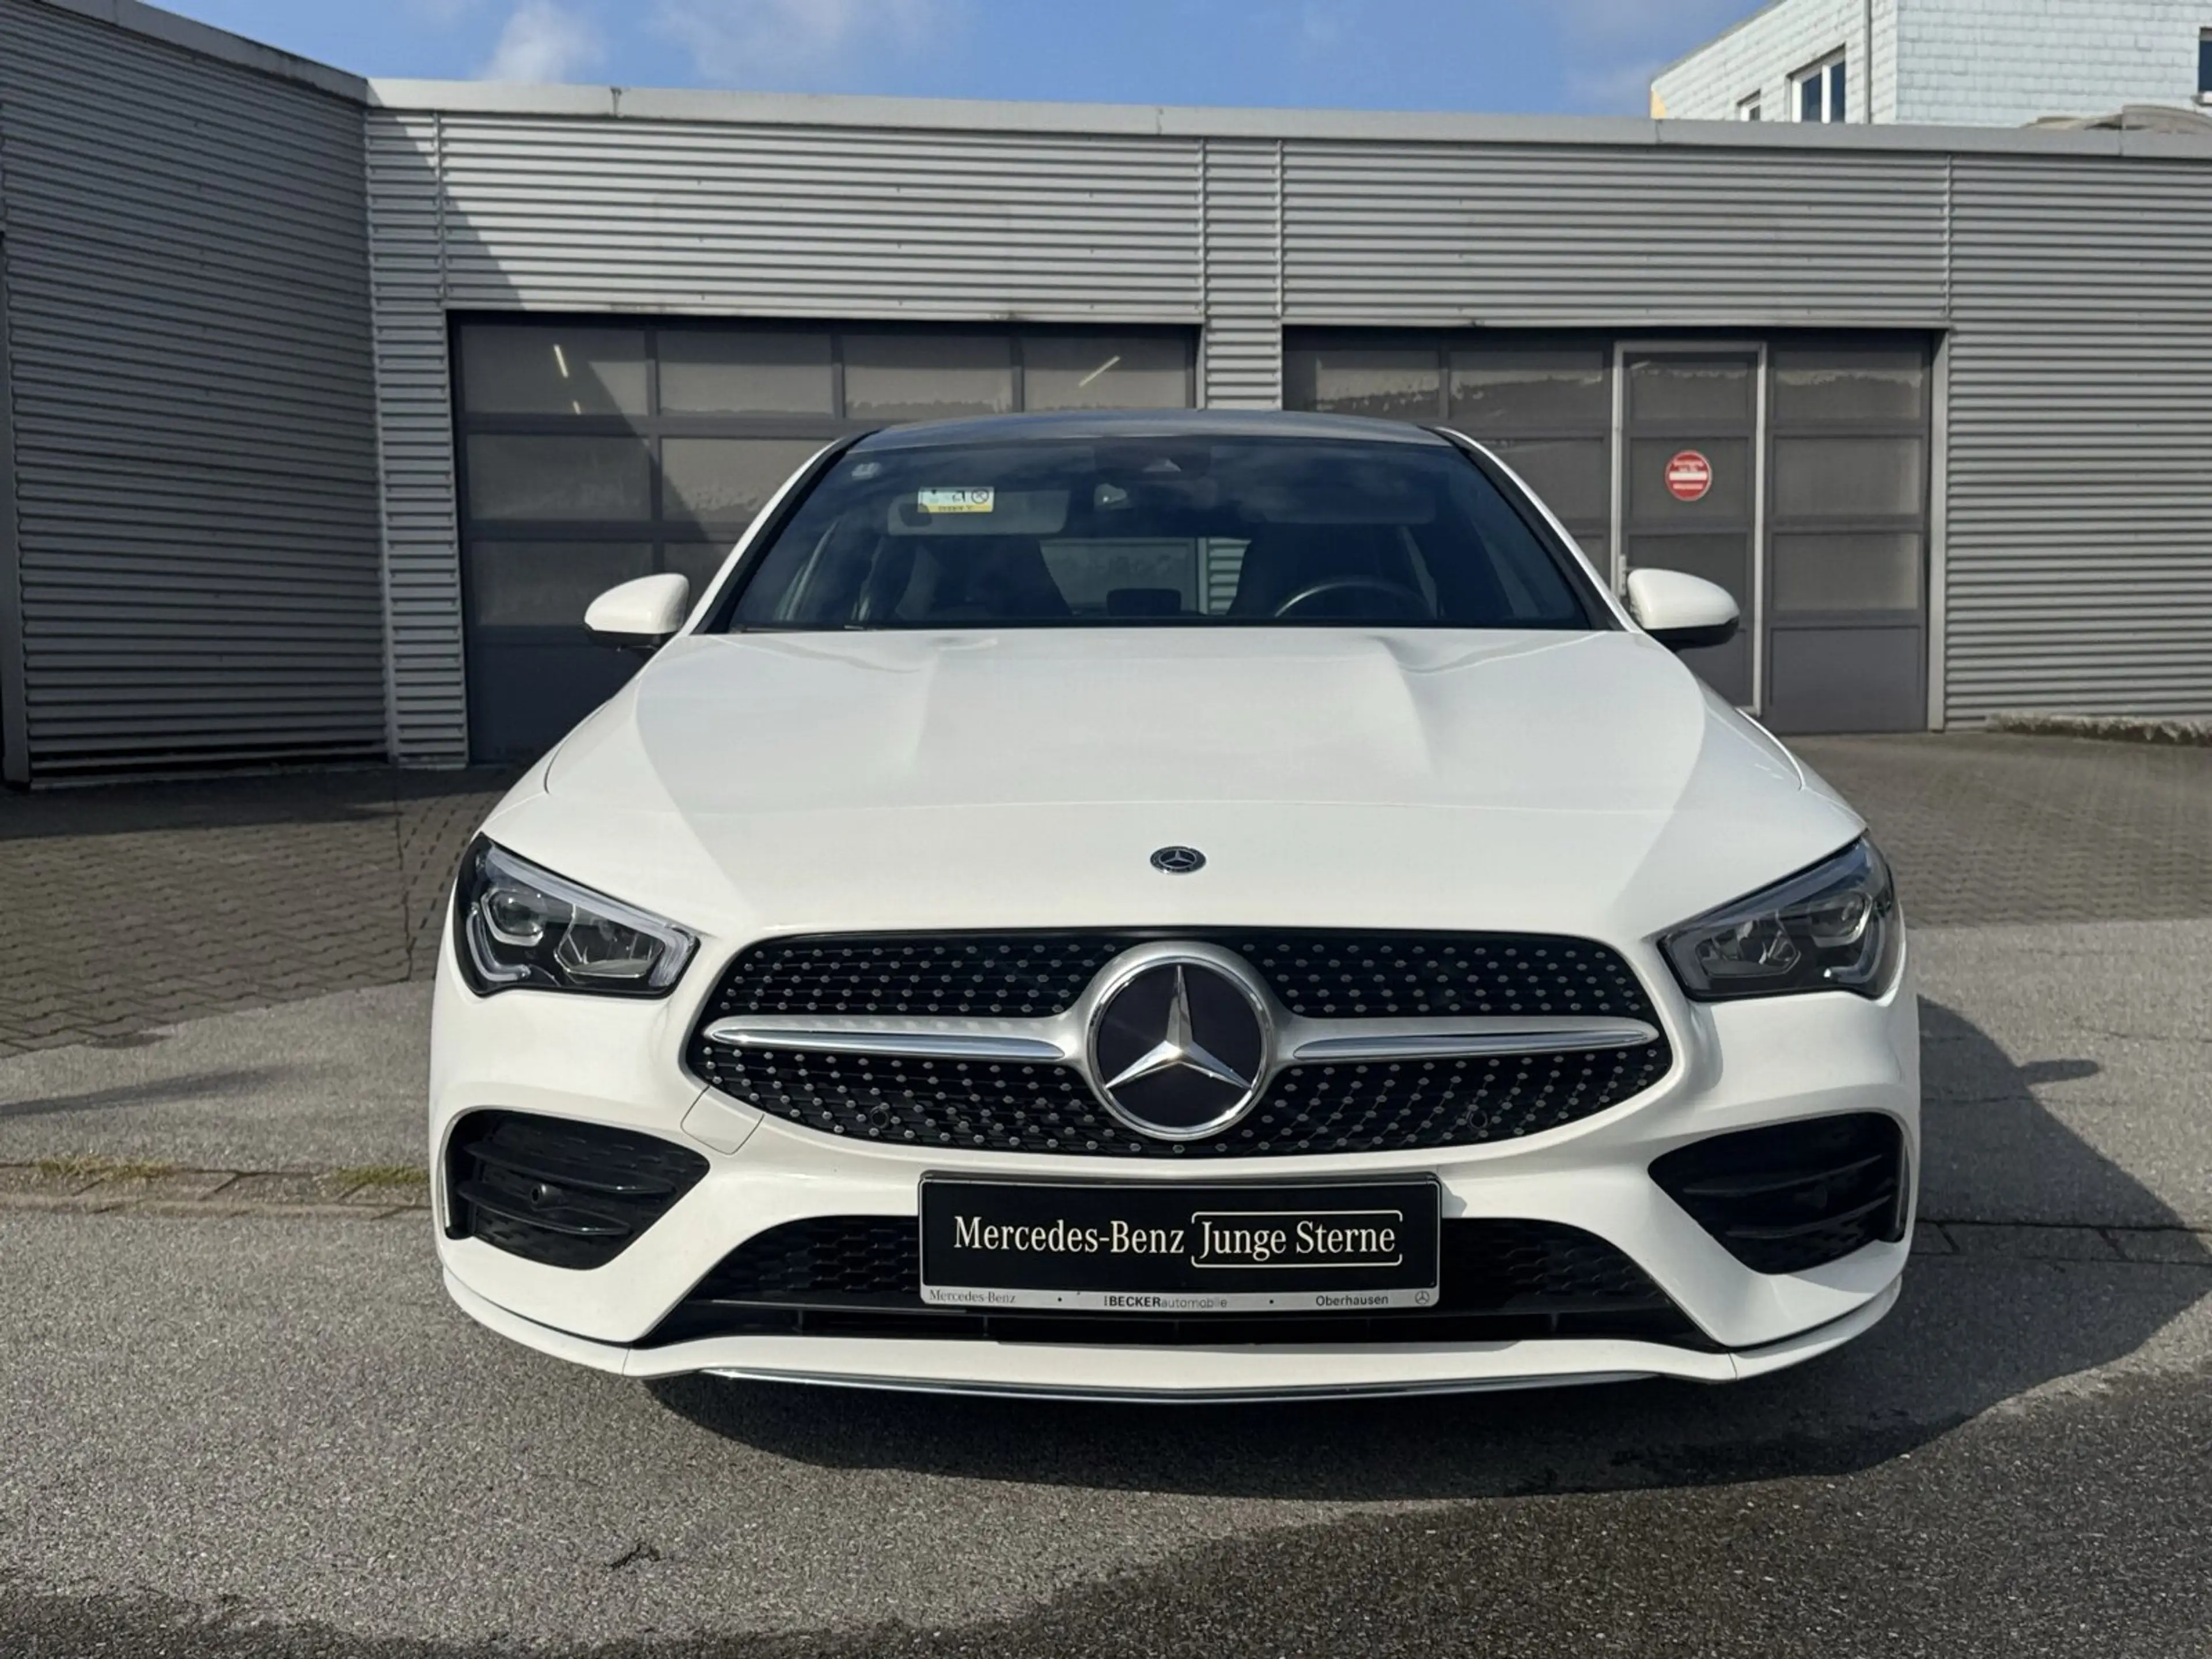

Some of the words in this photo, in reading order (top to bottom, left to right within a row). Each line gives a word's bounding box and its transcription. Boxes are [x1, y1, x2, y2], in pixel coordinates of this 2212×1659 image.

[953, 1215, 1185, 1253] Mercedes-Benz
[1199, 1220, 1286, 1262] Junge
[1296, 1219, 1396, 1254] Sterne
[929, 1289, 1017, 1304] Mercedes-Benz
[1315, 1294, 1389, 1307] Oberhausen
